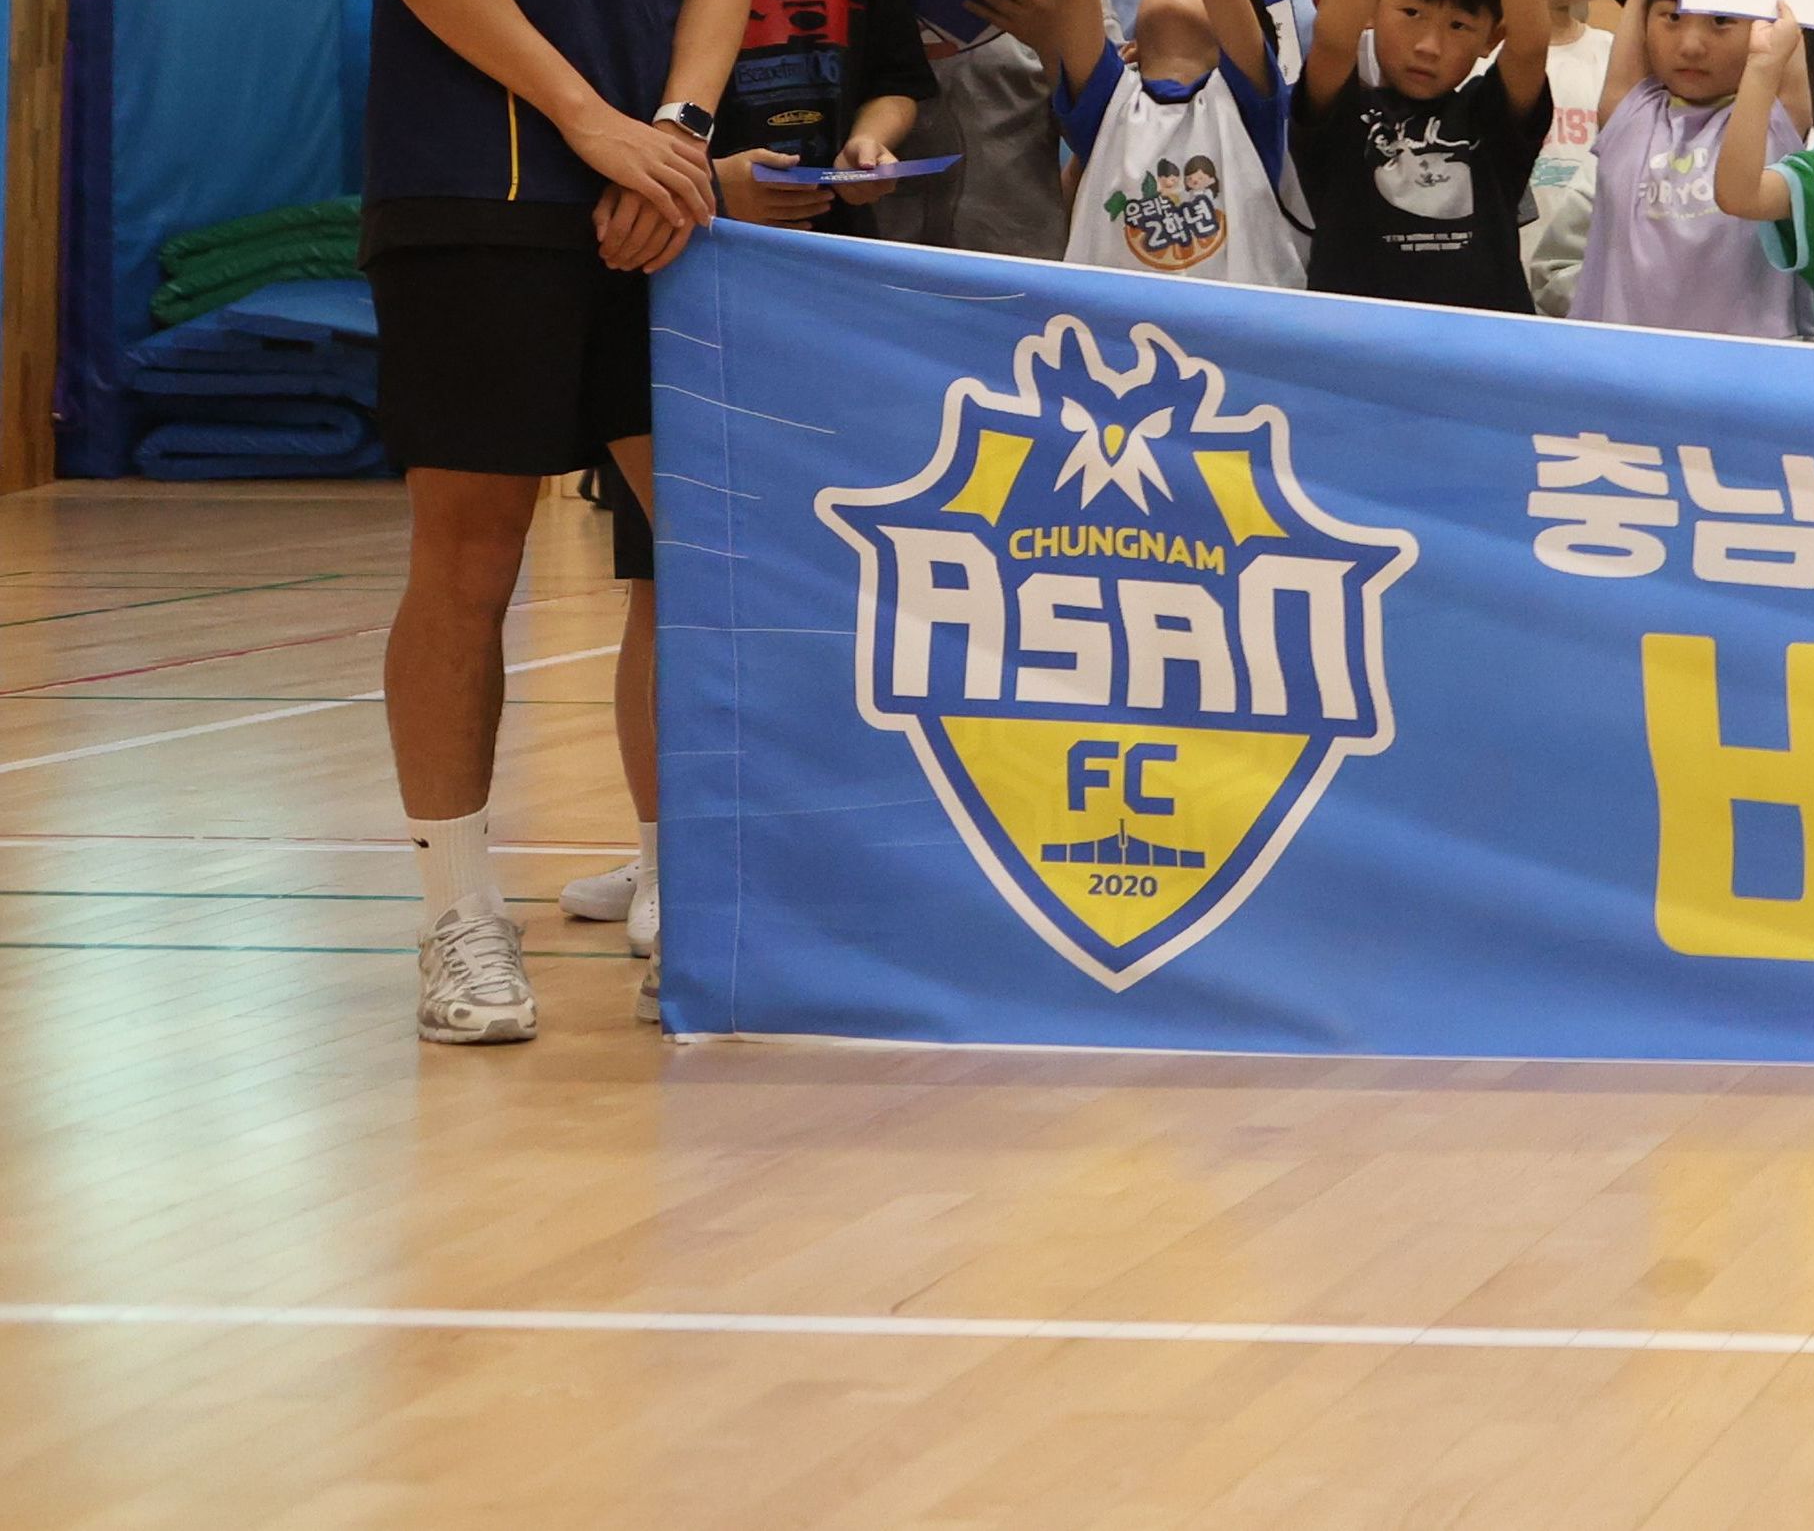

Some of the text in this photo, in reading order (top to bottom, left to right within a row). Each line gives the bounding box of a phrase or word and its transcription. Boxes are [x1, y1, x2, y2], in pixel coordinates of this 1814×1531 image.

[1126, 195, 1172, 226] 우리는
[1145, 199, 1216, 247] 2학년
[1008, 525, 1226, 575] CHUNGNAM
[876, 524, 1359, 721] ASAN
[1067, 739, 1178, 816] FC
[1087, 873, 1158, 899] 2020
